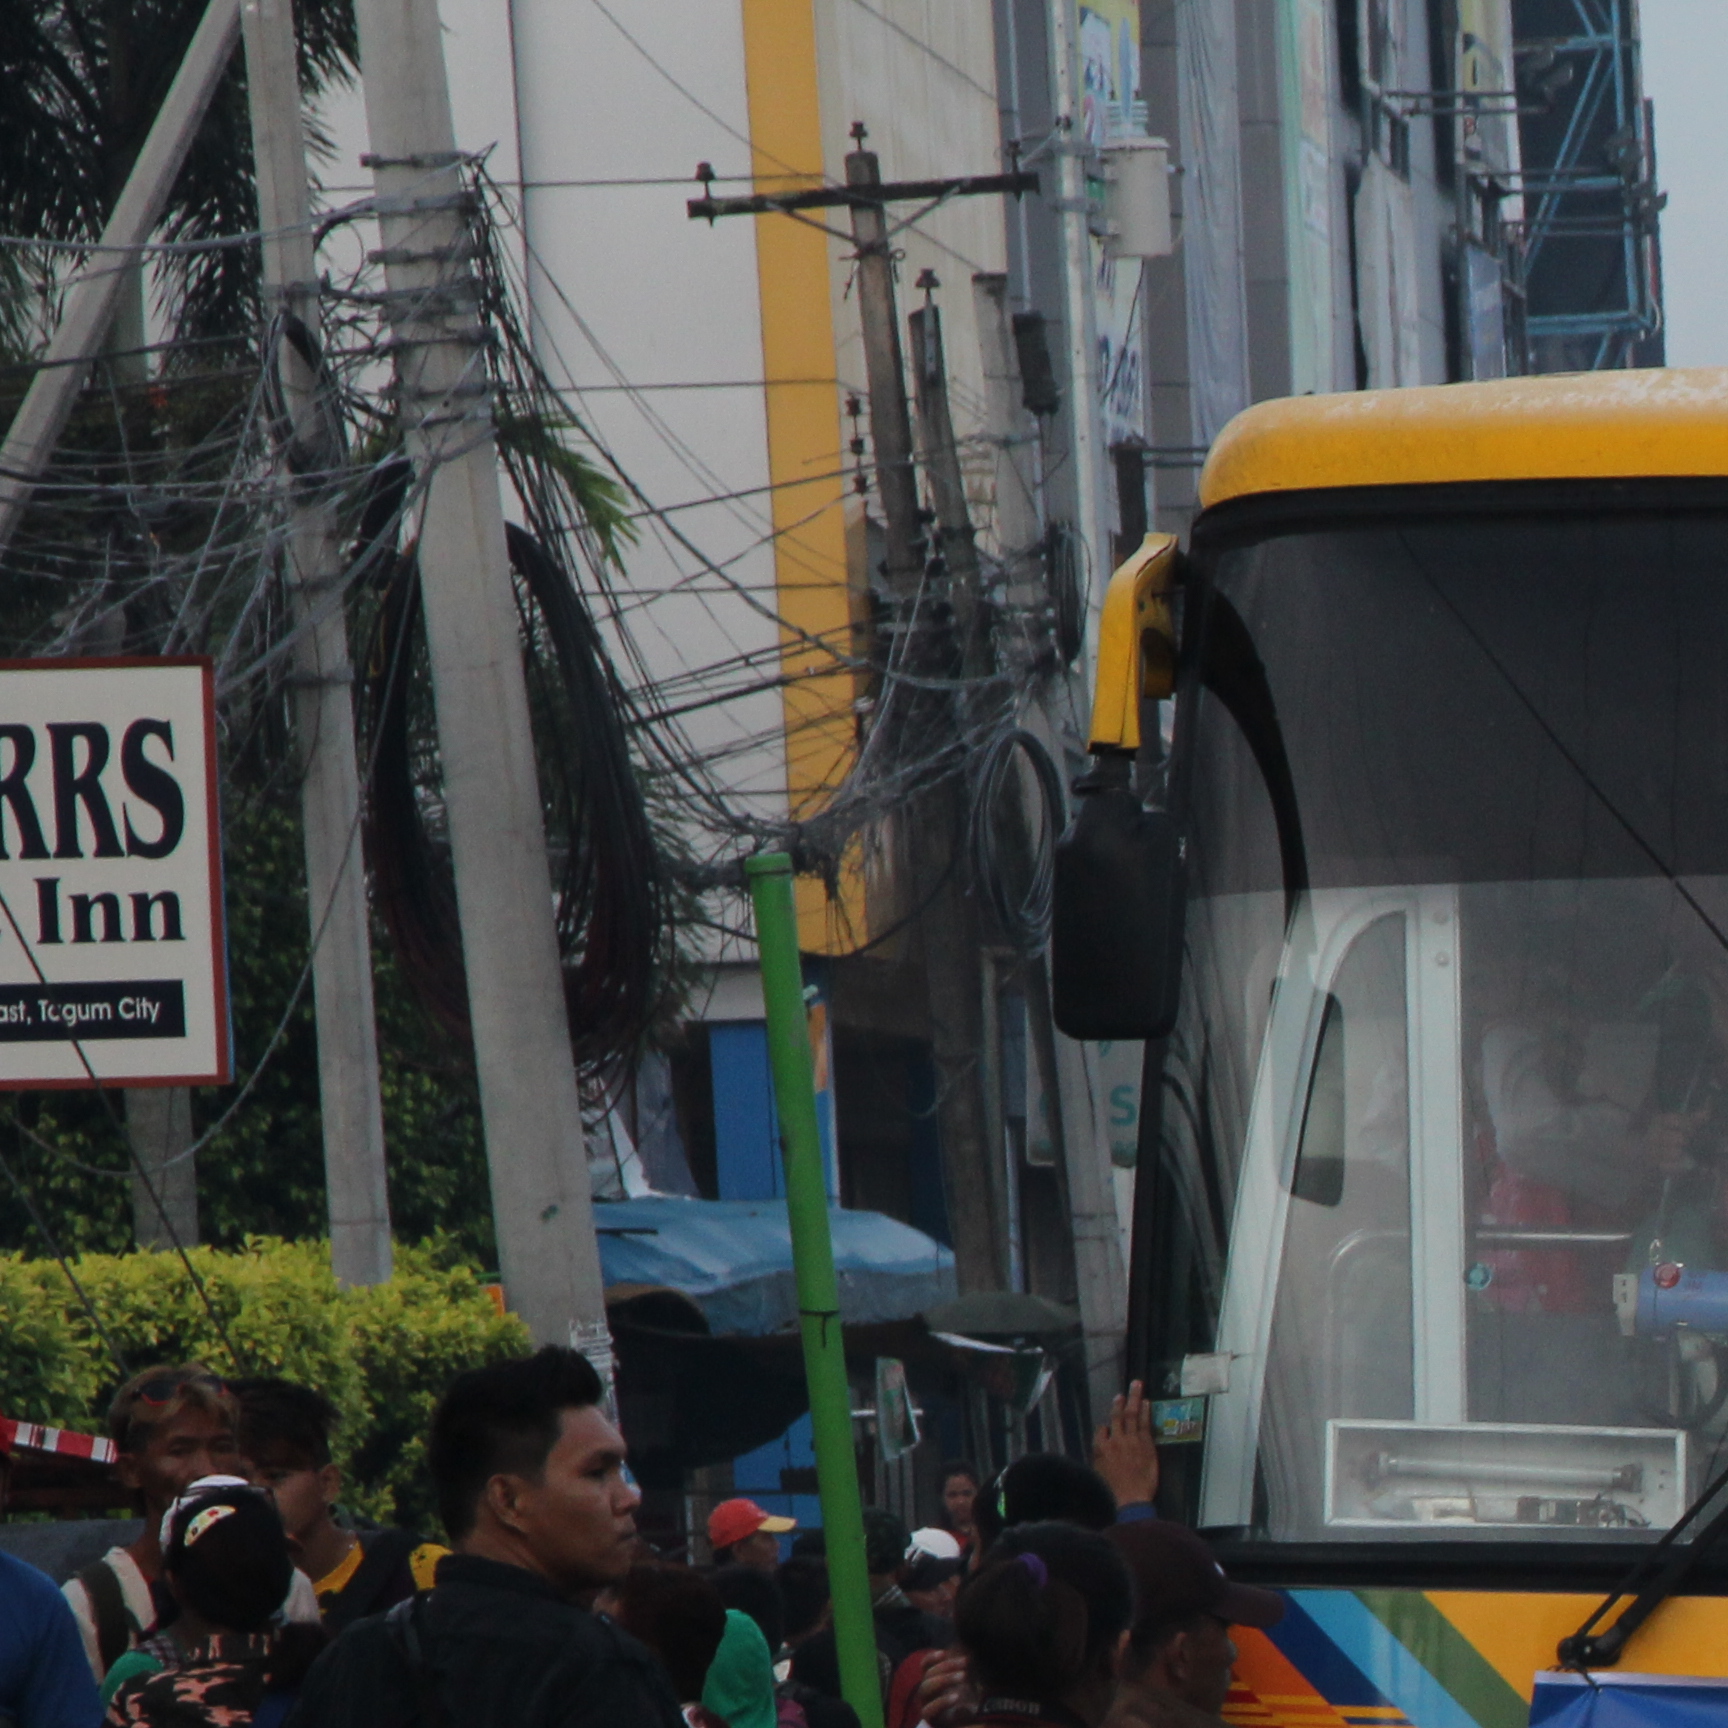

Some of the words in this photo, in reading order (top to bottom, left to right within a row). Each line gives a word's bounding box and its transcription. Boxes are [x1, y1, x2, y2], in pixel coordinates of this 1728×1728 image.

[33, 877, 186, 944] Inn
[37, 998, 112, 1027] Tagum
[118, 996, 161, 1024] City
